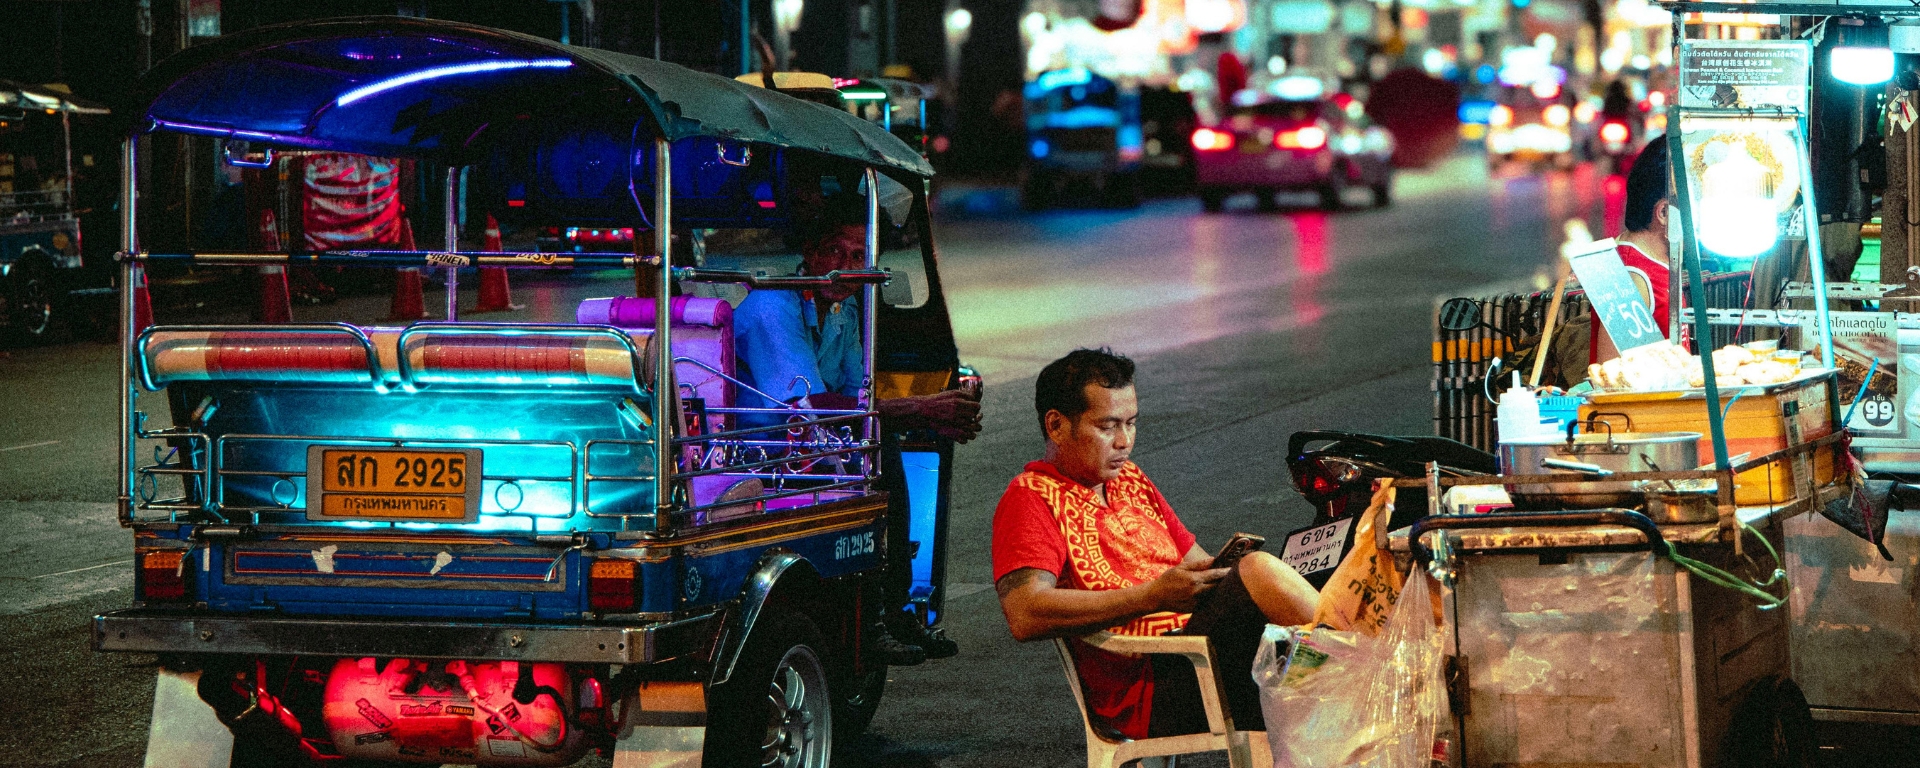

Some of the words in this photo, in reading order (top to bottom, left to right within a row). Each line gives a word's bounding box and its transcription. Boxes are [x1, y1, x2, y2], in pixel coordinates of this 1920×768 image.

[1813, 316, 1887, 331] ช็กโกแลตดูไบ
[1865, 401, 1893, 420] 99
[337, 453, 378, 487] สก
[394, 457, 464, 487] 2925
[343, 496, 447, 514] กรุงเทพมหานคร
[1292, 554, 1330, 575] 284
[452, 706, 473, 714] YAMAHA
